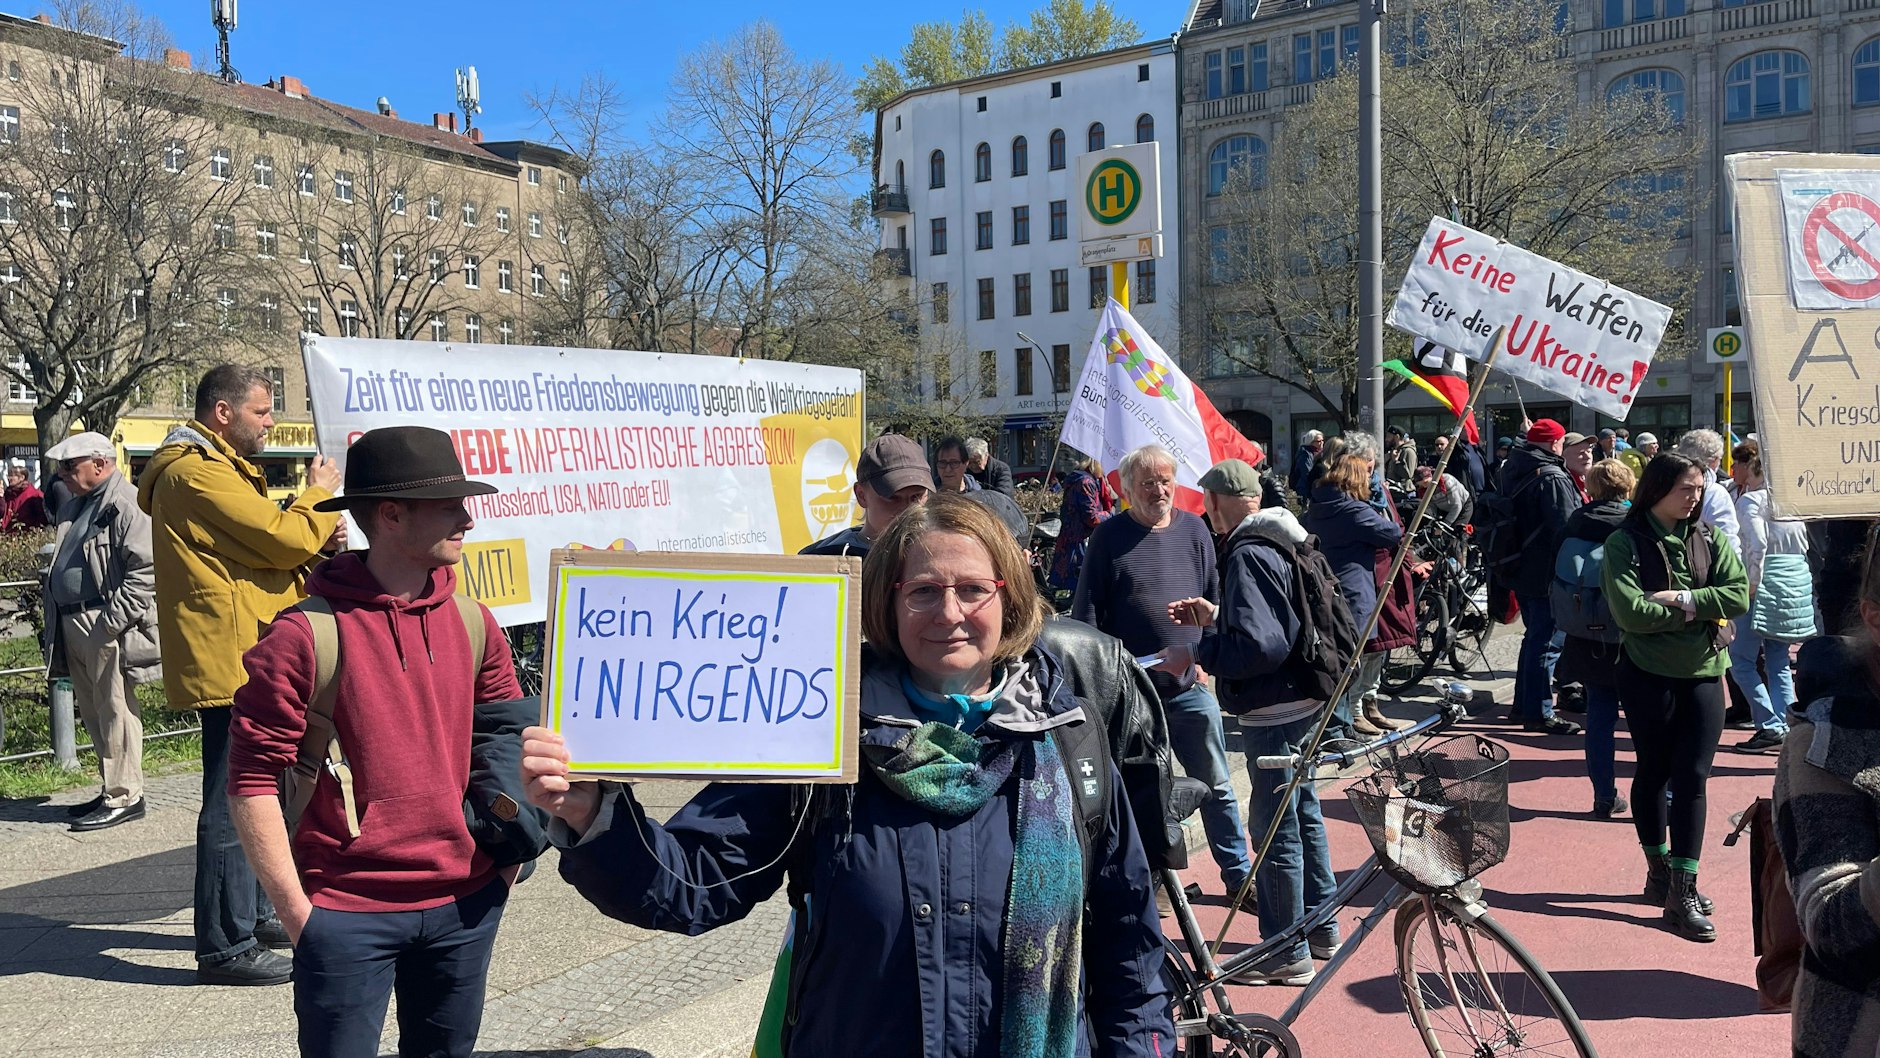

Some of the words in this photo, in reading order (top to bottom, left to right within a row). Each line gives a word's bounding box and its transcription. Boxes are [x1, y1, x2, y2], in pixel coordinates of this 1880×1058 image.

[1098, 172, 1125, 211] H
[1427, 230, 1516, 293] Keine
[1545, 272, 1643, 343] Waffen
[1421, 291, 1456, 322] für
[1462, 309, 1492, 337] die
[1506, 314, 1649, 404] Ukraine!
[1720, 337, 1733, 351] H
[1788, 318, 1880, 382] A
[339, 367, 388, 413] Zeit
[389, 368, 425, 412] für
[428, 372, 477, 412] eine
[479, 376, 532, 412] neue
[532, 372, 700, 417] Friedensbewegung
[701, 383, 746, 417] gegen
[746, 379, 768, 413] die
[766, 380, 857, 421] Weltkriegsgefahr!
[1017, 400, 1034, 409] ART
[1035, 400, 1045, 408] en
[513, 426, 700, 474] IMPERIALISTISCHE
[703, 426, 797, 467] AGGRESSION!
[480, 485, 554, 519] Russland,
[553, 483, 586, 514] USA,
[586, 481, 621, 512] NATO
[623, 480, 650, 508] oder
[651, 479, 672, 506] EU!
[656, 529, 768, 551] Internationalistisches
[462, 548, 515, 600] MIT!
[577, 587, 652, 638] kein
[672, 586, 789, 664] Krieg!
